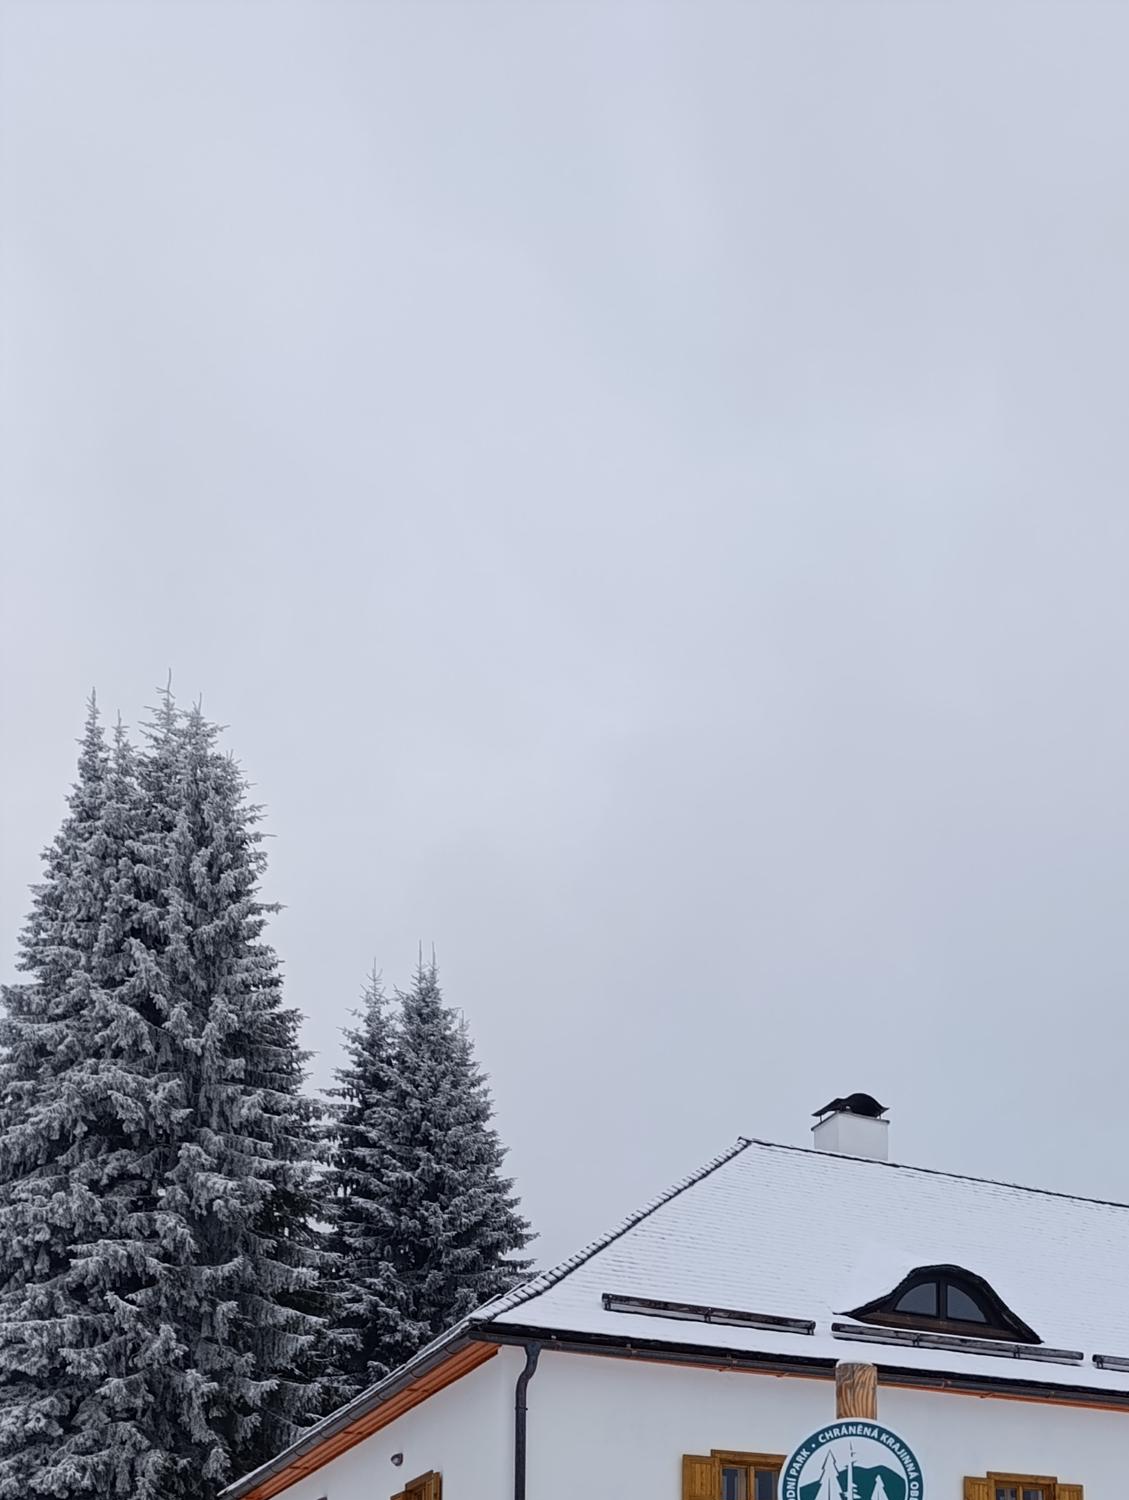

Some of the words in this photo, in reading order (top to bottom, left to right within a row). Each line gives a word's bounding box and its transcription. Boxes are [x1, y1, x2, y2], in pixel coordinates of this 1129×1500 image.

[790, 1448, 811, 1476] PARK
[818, 1424, 880, 1443] CHRÁNĚNÁ
[879, 1433, 919, 1480] KRAJINNÁ
